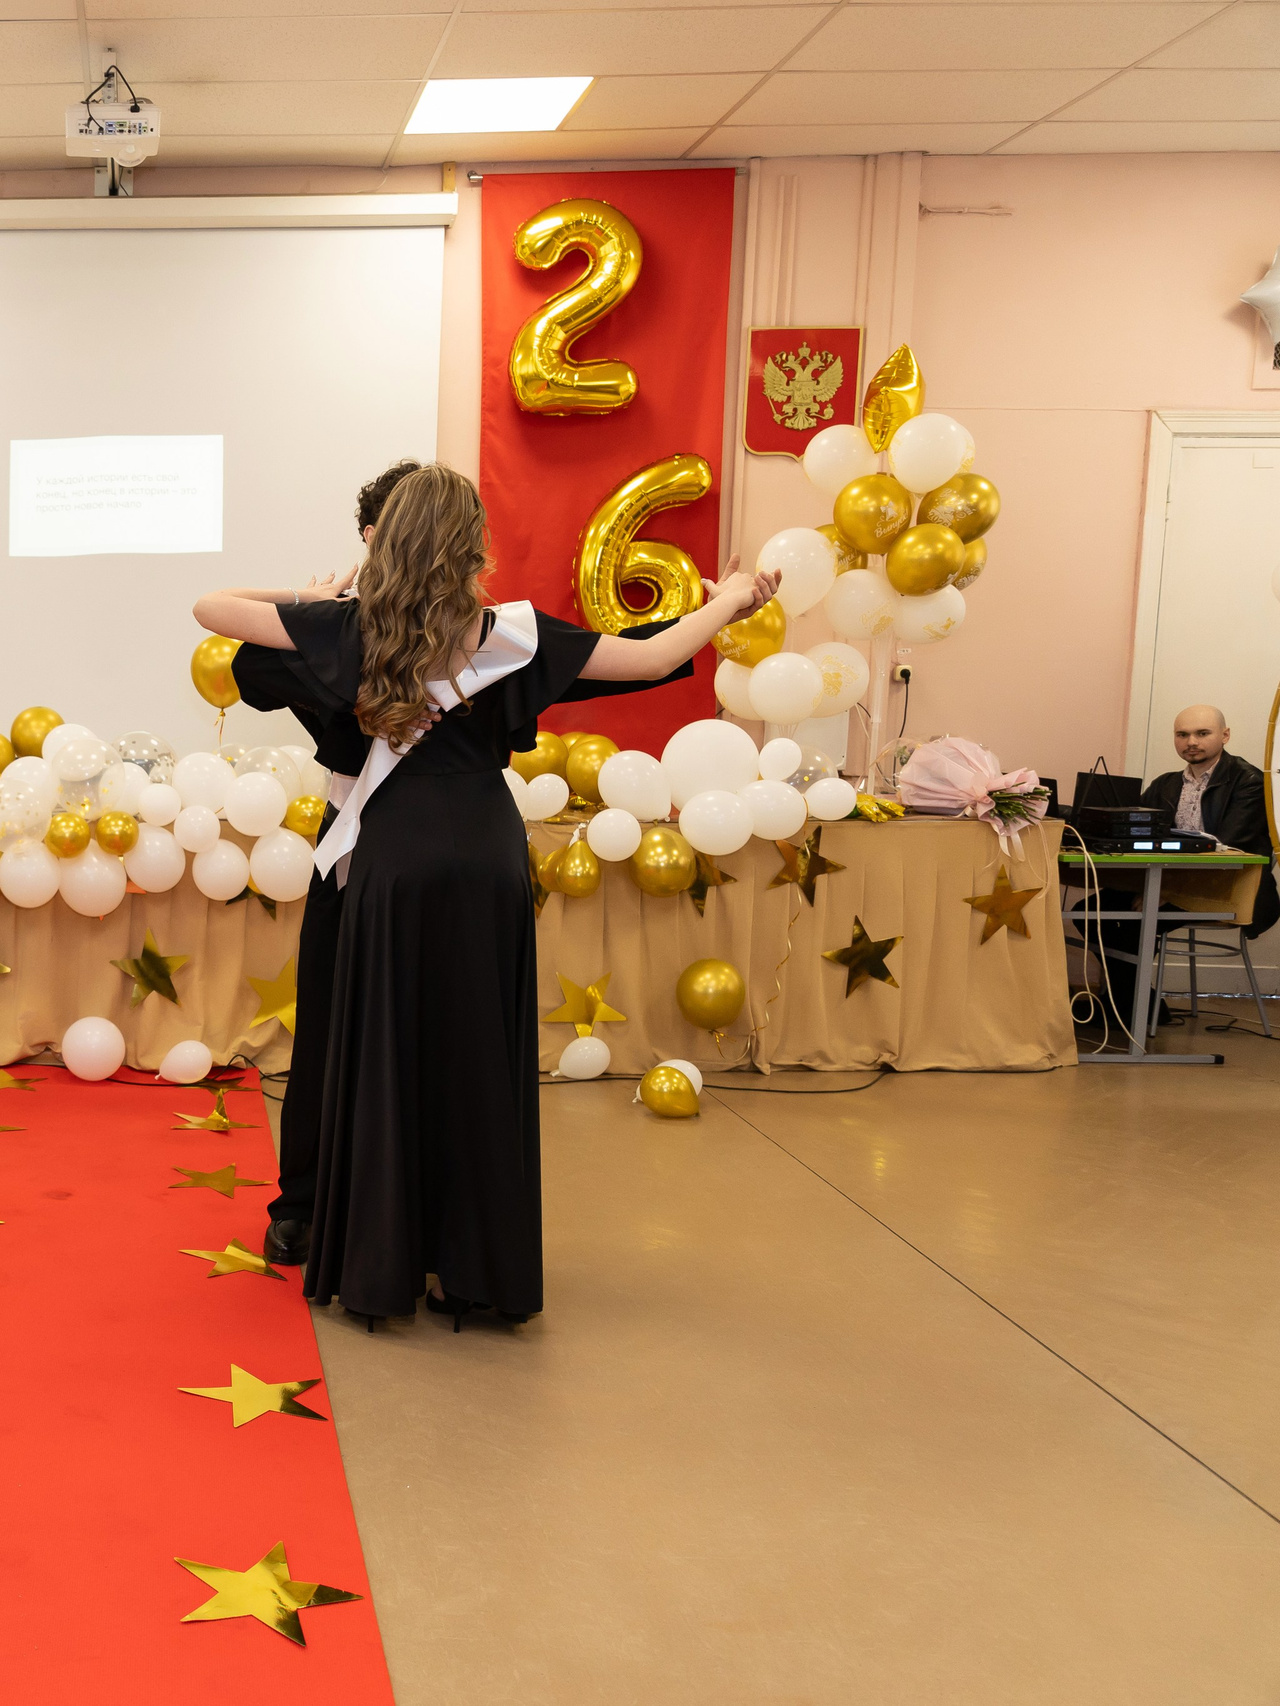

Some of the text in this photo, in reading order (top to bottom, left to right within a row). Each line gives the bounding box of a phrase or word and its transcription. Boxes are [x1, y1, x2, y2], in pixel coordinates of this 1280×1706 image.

[508, 198, 643, 416] 2
[46, 473, 84, 485] каждой
[87, 473, 128, 484] истории
[131, 473, 153, 483] есть
[156, 472, 180, 483] свой
[86, 488, 116, 498] конец
[128, 487, 169, 497] истории
[181, 487, 199, 496] это
[35, 500, 142, 514] просто новое начало
[573, 453, 713, 637] 6
